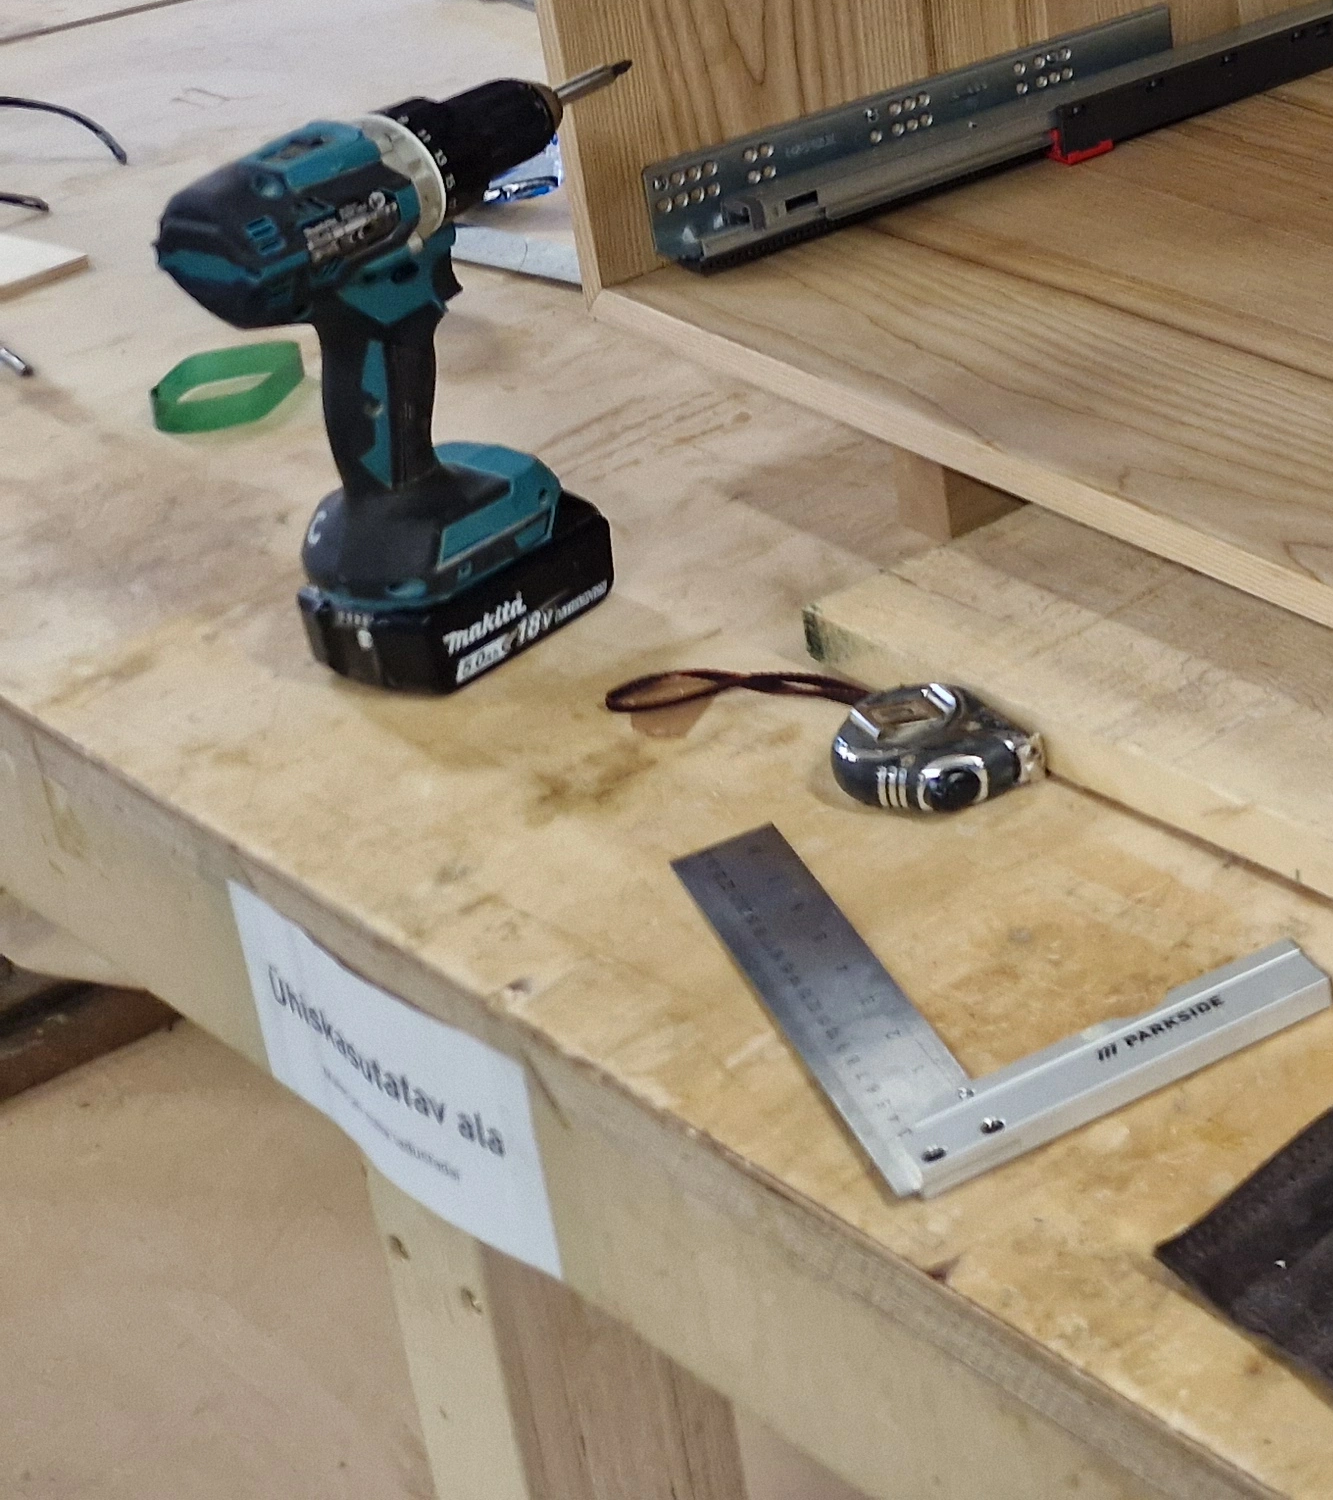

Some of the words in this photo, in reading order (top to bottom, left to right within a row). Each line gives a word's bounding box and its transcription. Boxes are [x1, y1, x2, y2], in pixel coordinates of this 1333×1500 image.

[442, 591, 527, 657] makita
[517, 609, 553, 647] 18V
[1123, 994, 1225, 1048] PARKSIDE
[457, 1111, 506, 1158] ala
